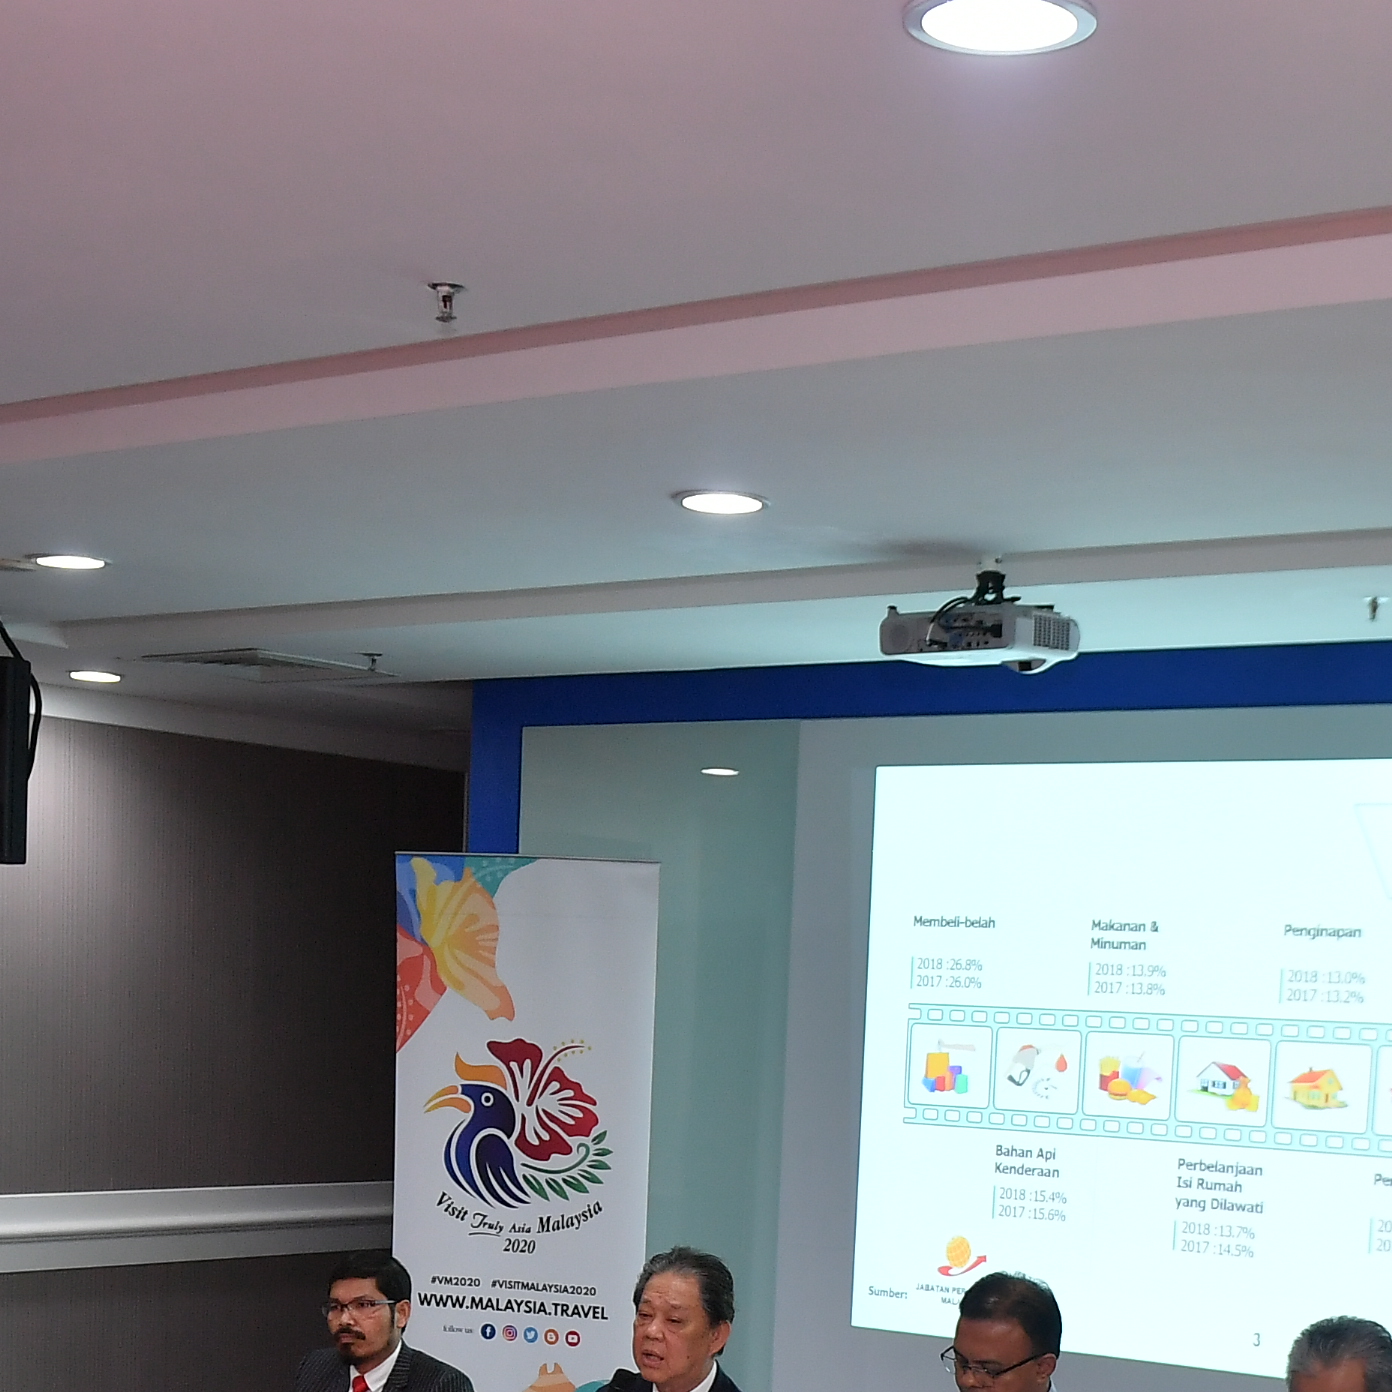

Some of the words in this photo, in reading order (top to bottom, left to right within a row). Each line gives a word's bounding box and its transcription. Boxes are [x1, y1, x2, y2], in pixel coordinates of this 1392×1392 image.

[913, 915, 996, 929] Membeli-belah
[1091, 919, 1146, 932] Makanan
[1150, 921, 1159, 933] &
[1284, 924, 1362, 940] Penginapan
[1090, 937, 1147, 950] Minuman
[917, 957, 942, 970] 2018
[1095, 963, 1123, 976] 2018
[916, 975, 942, 988] 2017
[1287, 969, 1318, 983] 2018
[1094, 981, 1122, 994] 2017
[1286, 988, 1316, 1002] 2017
[996, 1144, 1033, 1159] Bahan
[1036, 1147, 1057, 1162] Api
[995, 1162, 1060, 1178] Kenderaan
[1178, 1158, 1263, 1177] Perbelanjaan
[1176, 1176, 1193, 1189] Isi
[1197, 1177, 1243, 1193] Rumah
[999, 1187, 1026, 1201] 2018
[998, 1205, 1025, 1218] 2017
[1175, 1195, 1206, 1212] yang
[1210, 1198, 1264, 1214] Dilawati
[436, 1191, 469, 1221] Visit
[470, 1212, 504, 1234] Truly
[508, 1222, 532, 1234] Asia
[536, 1200, 603, 1234] Malaysia
[1182, 1221, 1211, 1236] 2018
[503, 1238, 536, 1254] 2020
[1181, 1240, 1209, 1254] 2017
[430, 1276, 481, 1288] #VM2020
[490, 1280, 597, 1296] #VISITMALAYSIA2020
[868, 1286, 908, 1299] Sumber:
[916, 1283, 950, 1293] JABATAN
[418, 1292, 609, 1320] WWW.MALAYSIA.TRAVEL
[1253, 1332, 1261, 1347] 3
